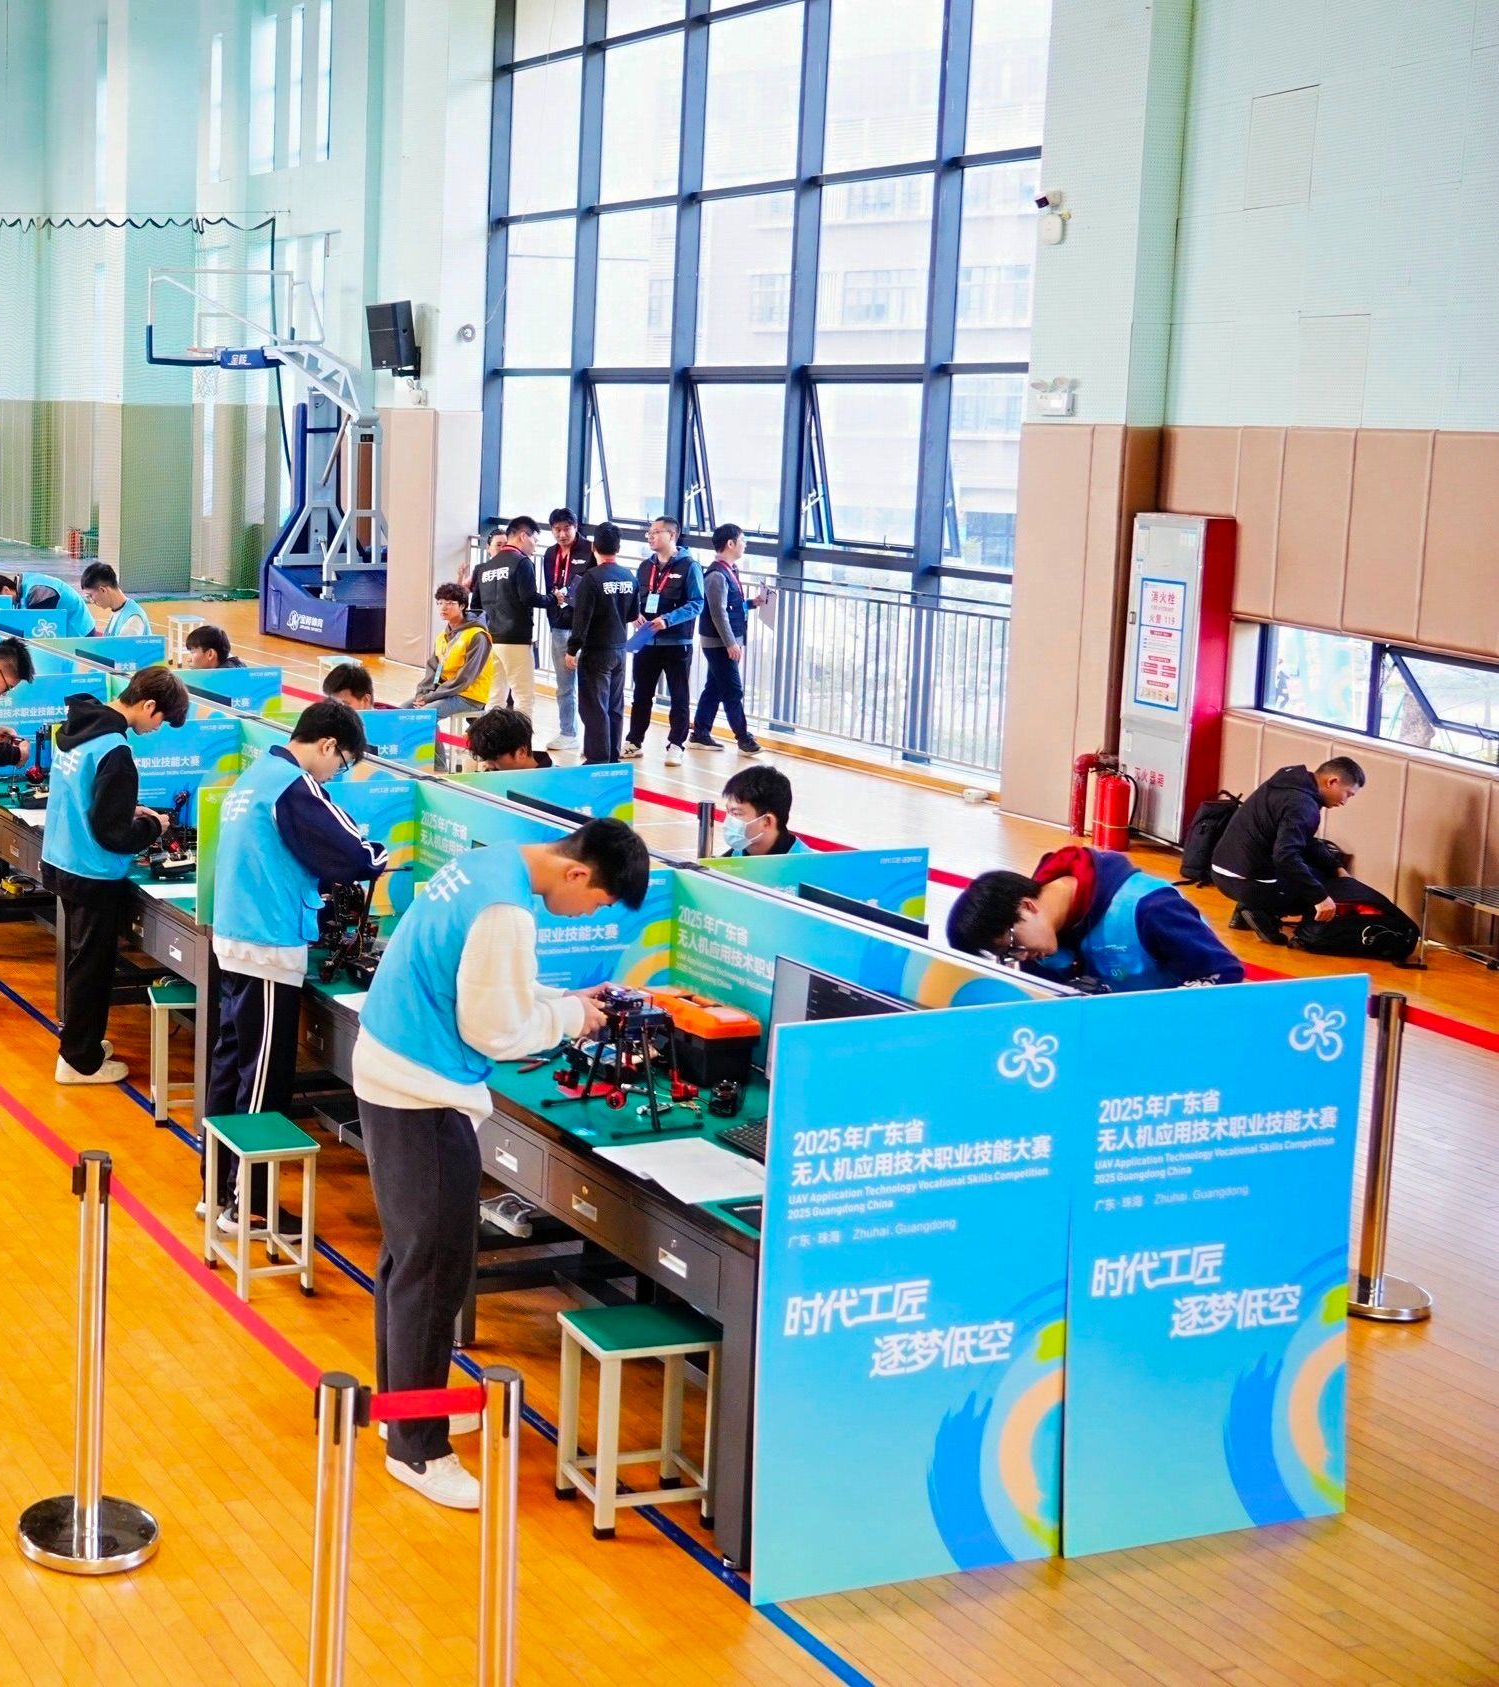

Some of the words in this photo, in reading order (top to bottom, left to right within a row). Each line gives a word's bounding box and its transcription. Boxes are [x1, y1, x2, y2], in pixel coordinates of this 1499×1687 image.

[1111, 968, 1123, 977] 01
[1099, 1089, 1220, 1123] 2025年广东省
[793, 1119, 925, 1157] 2025年广东省
[1097, 1106, 1338, 1152] 无人机应用技术职业技能大赛
[791, 1135, 1052, 1187] 无人机应用技术职业技能大赛
[1094, 1159, 1113, 1170] UAV
[1114, 1154, 1163, 1169] Application
[1165, 1149, 1212, 1162] Technology
[1214, 1144, 1257, 1157] Vocational
[1258, 1141, 1283, 1152] Skills
[1284, 1136, 1335, 1150] Competition
[789, 1194, 809, 1205] UAV
[810, 1188, 862, 1204] Application
[865, 1181, 916, 1197] Technology
[918, 1175, 966, 1190] Vocational
[967, 1172, 992, 1185] Skills
[994, 1166, 1049, 1182] Competition
[1094, 1173, 1115, 1184] 2025
[1117, 1168, 1165, 1182] Guangdong
[1167, 1165, 1192, 1176] China
[1193, 1185, 1249, 1200] Guangdong
[788, 1208, 810, 1219] 2025
[812, 1203, 865, 1218] Guangdong
[867, 1198, 893, 1210] China
[895, 1219, 956, 1235] Guangdong
[1092, 1244, 1225, 1296] 时代工匠
[784, 1280, 931, 1336] 时代工匠
[1170, 1284, 1302, 1338] 逐梦低空
[870, 1321, 1014, 1378] 逐梦低空
